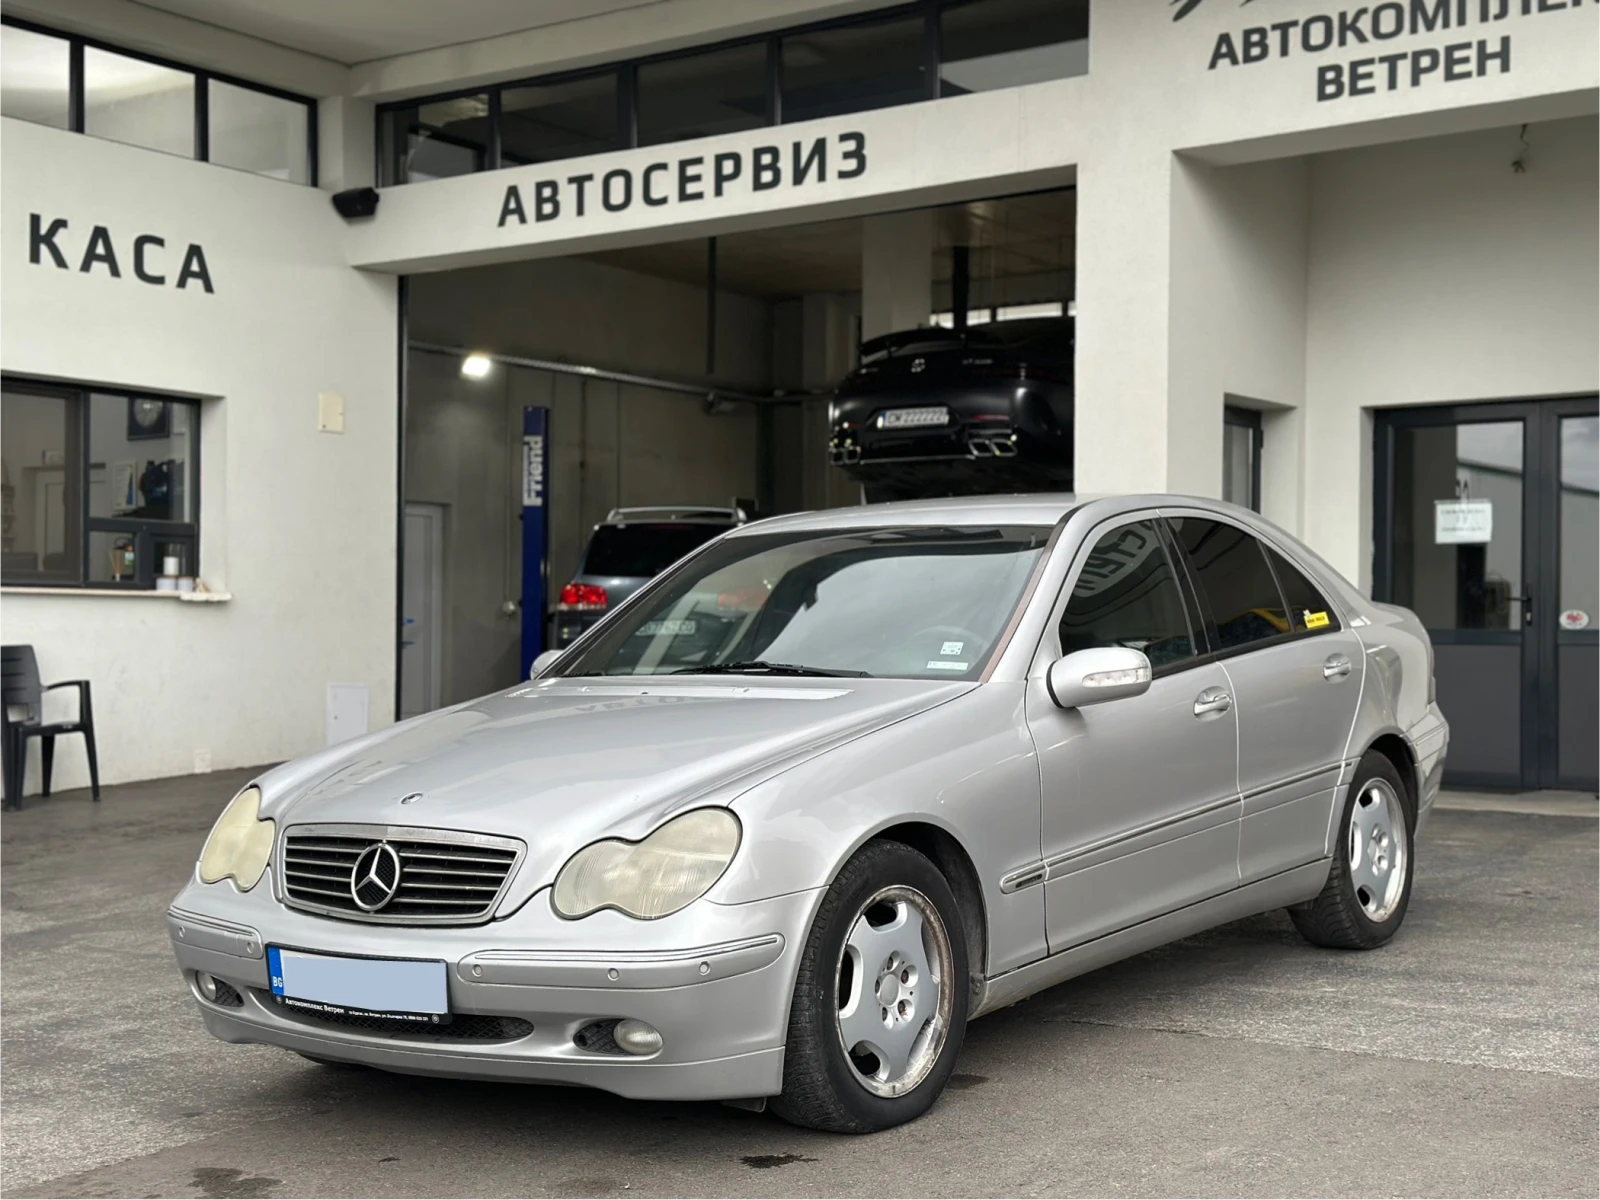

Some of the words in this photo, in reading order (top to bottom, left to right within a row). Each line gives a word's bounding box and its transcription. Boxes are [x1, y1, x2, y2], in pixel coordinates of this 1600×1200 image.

[1208, 0, 1597, 70] АВТОКОМП
[1317, 36, 1511, 102] ВЕТРЕН
[497, 131, 867, 228] АВТОСЕРВИЗ
[29, 213, 215, 294] КАСА
[522, 435, 543, 506] Friend
[272, 976, 283, 988] BG
